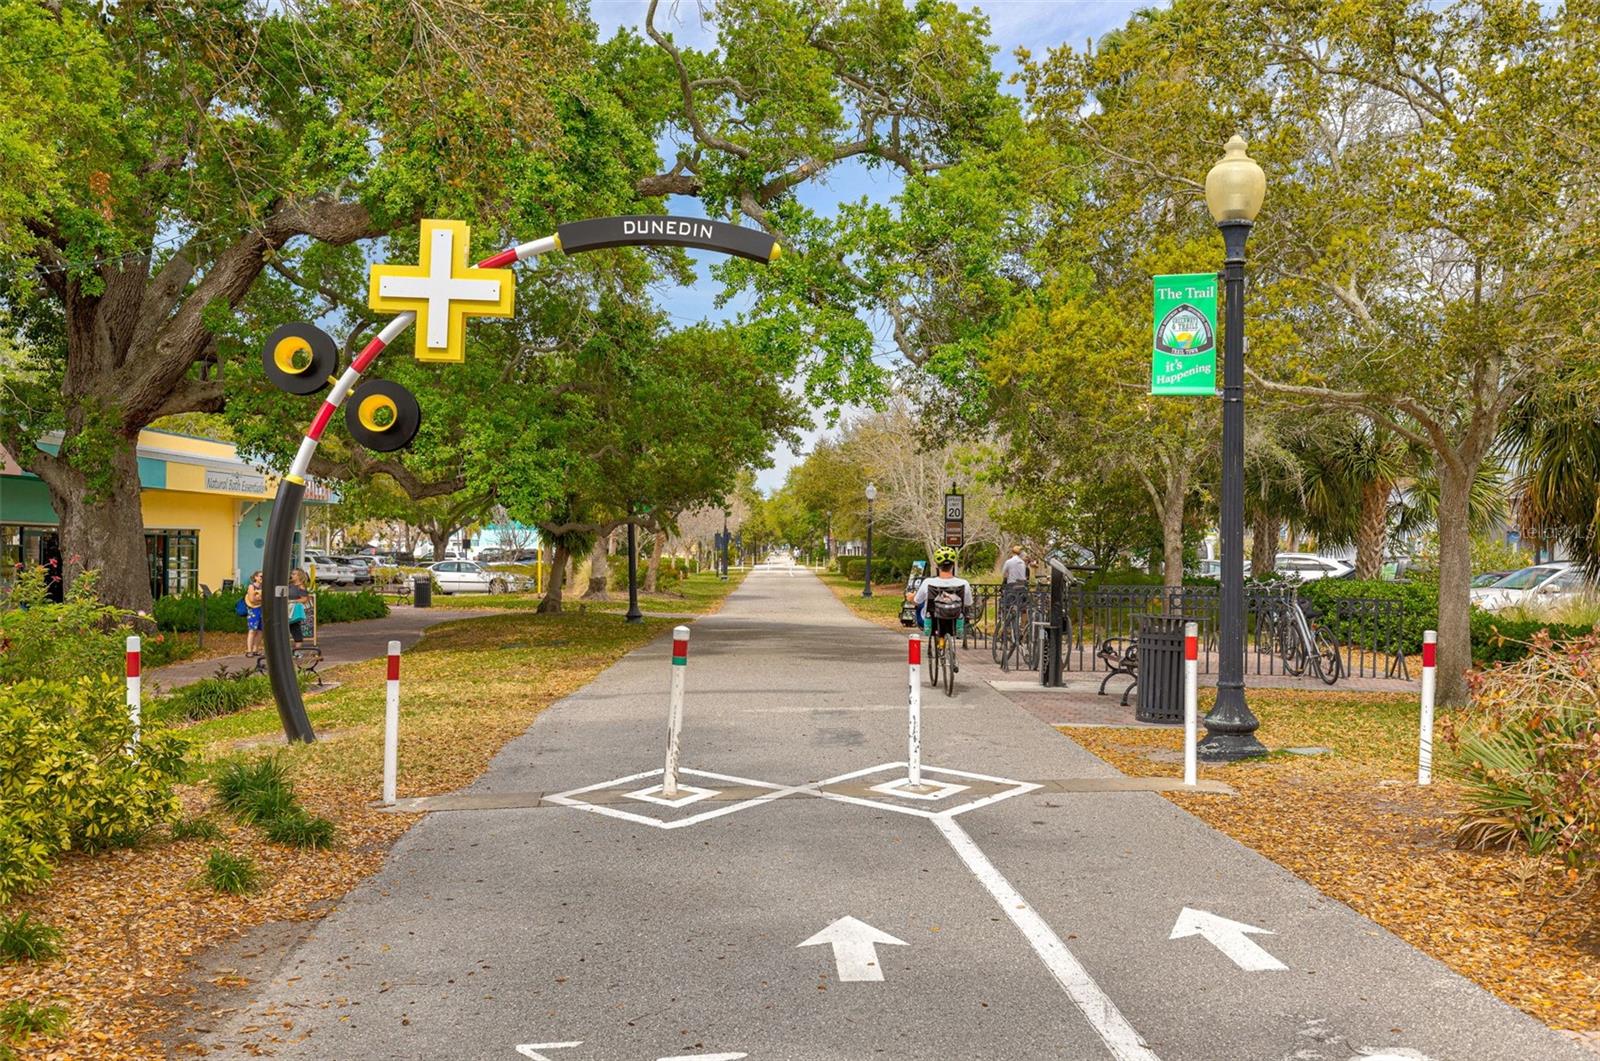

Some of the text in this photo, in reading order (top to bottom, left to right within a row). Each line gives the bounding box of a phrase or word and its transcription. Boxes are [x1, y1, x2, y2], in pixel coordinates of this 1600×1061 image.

[623, 220, 713, 239] DUNEDIN
[1157, 286, 1214, 300] The Trail
[1165, 359, 1182, 372] it's
[1157, 365, 1211, 384] Happening
[207, 478, 228, 491] Natural
[228, 479, 241, 492] Bath
[949, 508, 960, 517] 20
